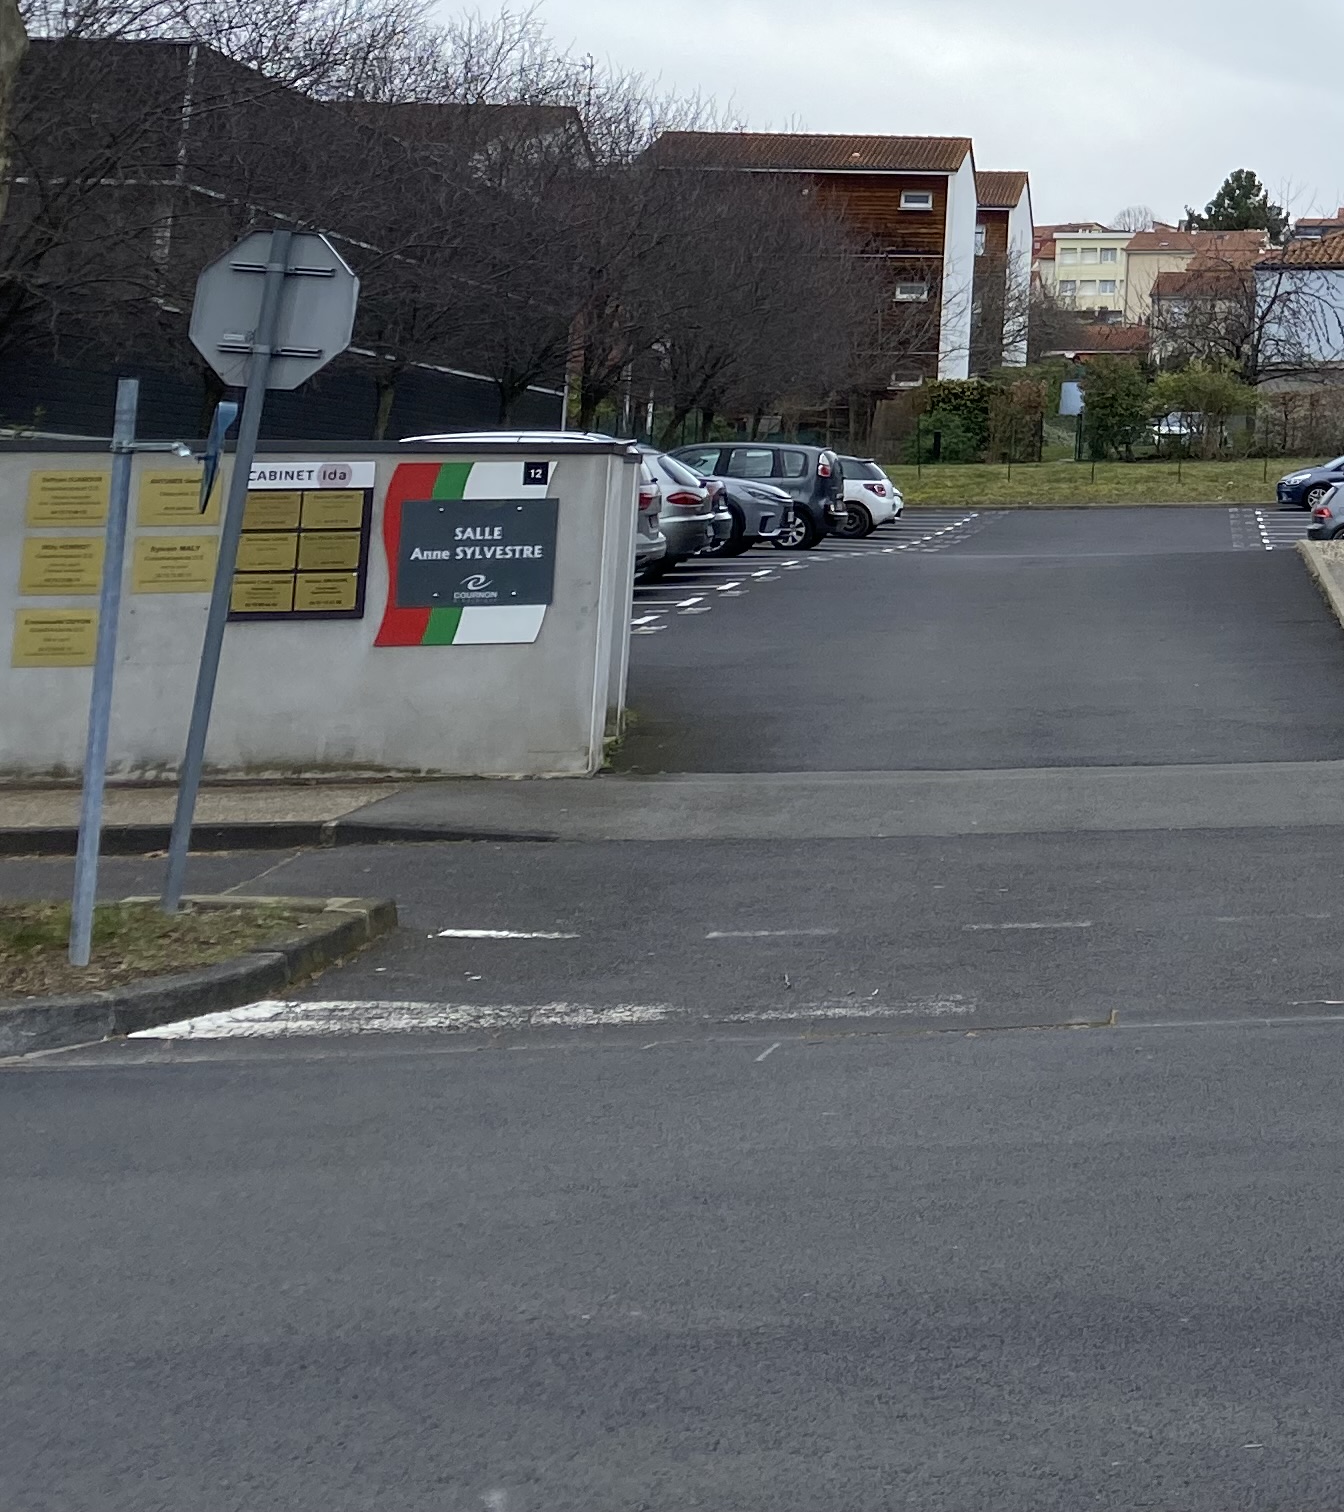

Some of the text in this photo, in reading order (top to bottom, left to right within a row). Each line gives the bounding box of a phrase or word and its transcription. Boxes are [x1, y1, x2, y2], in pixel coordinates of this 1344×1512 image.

[247, 470, 314, 482] CABINET
[529, 469, 543, 479] 12
[454, 526, 503, 541] SALLE
[410, 545, 544, 561] Anne SYLVESTRE
